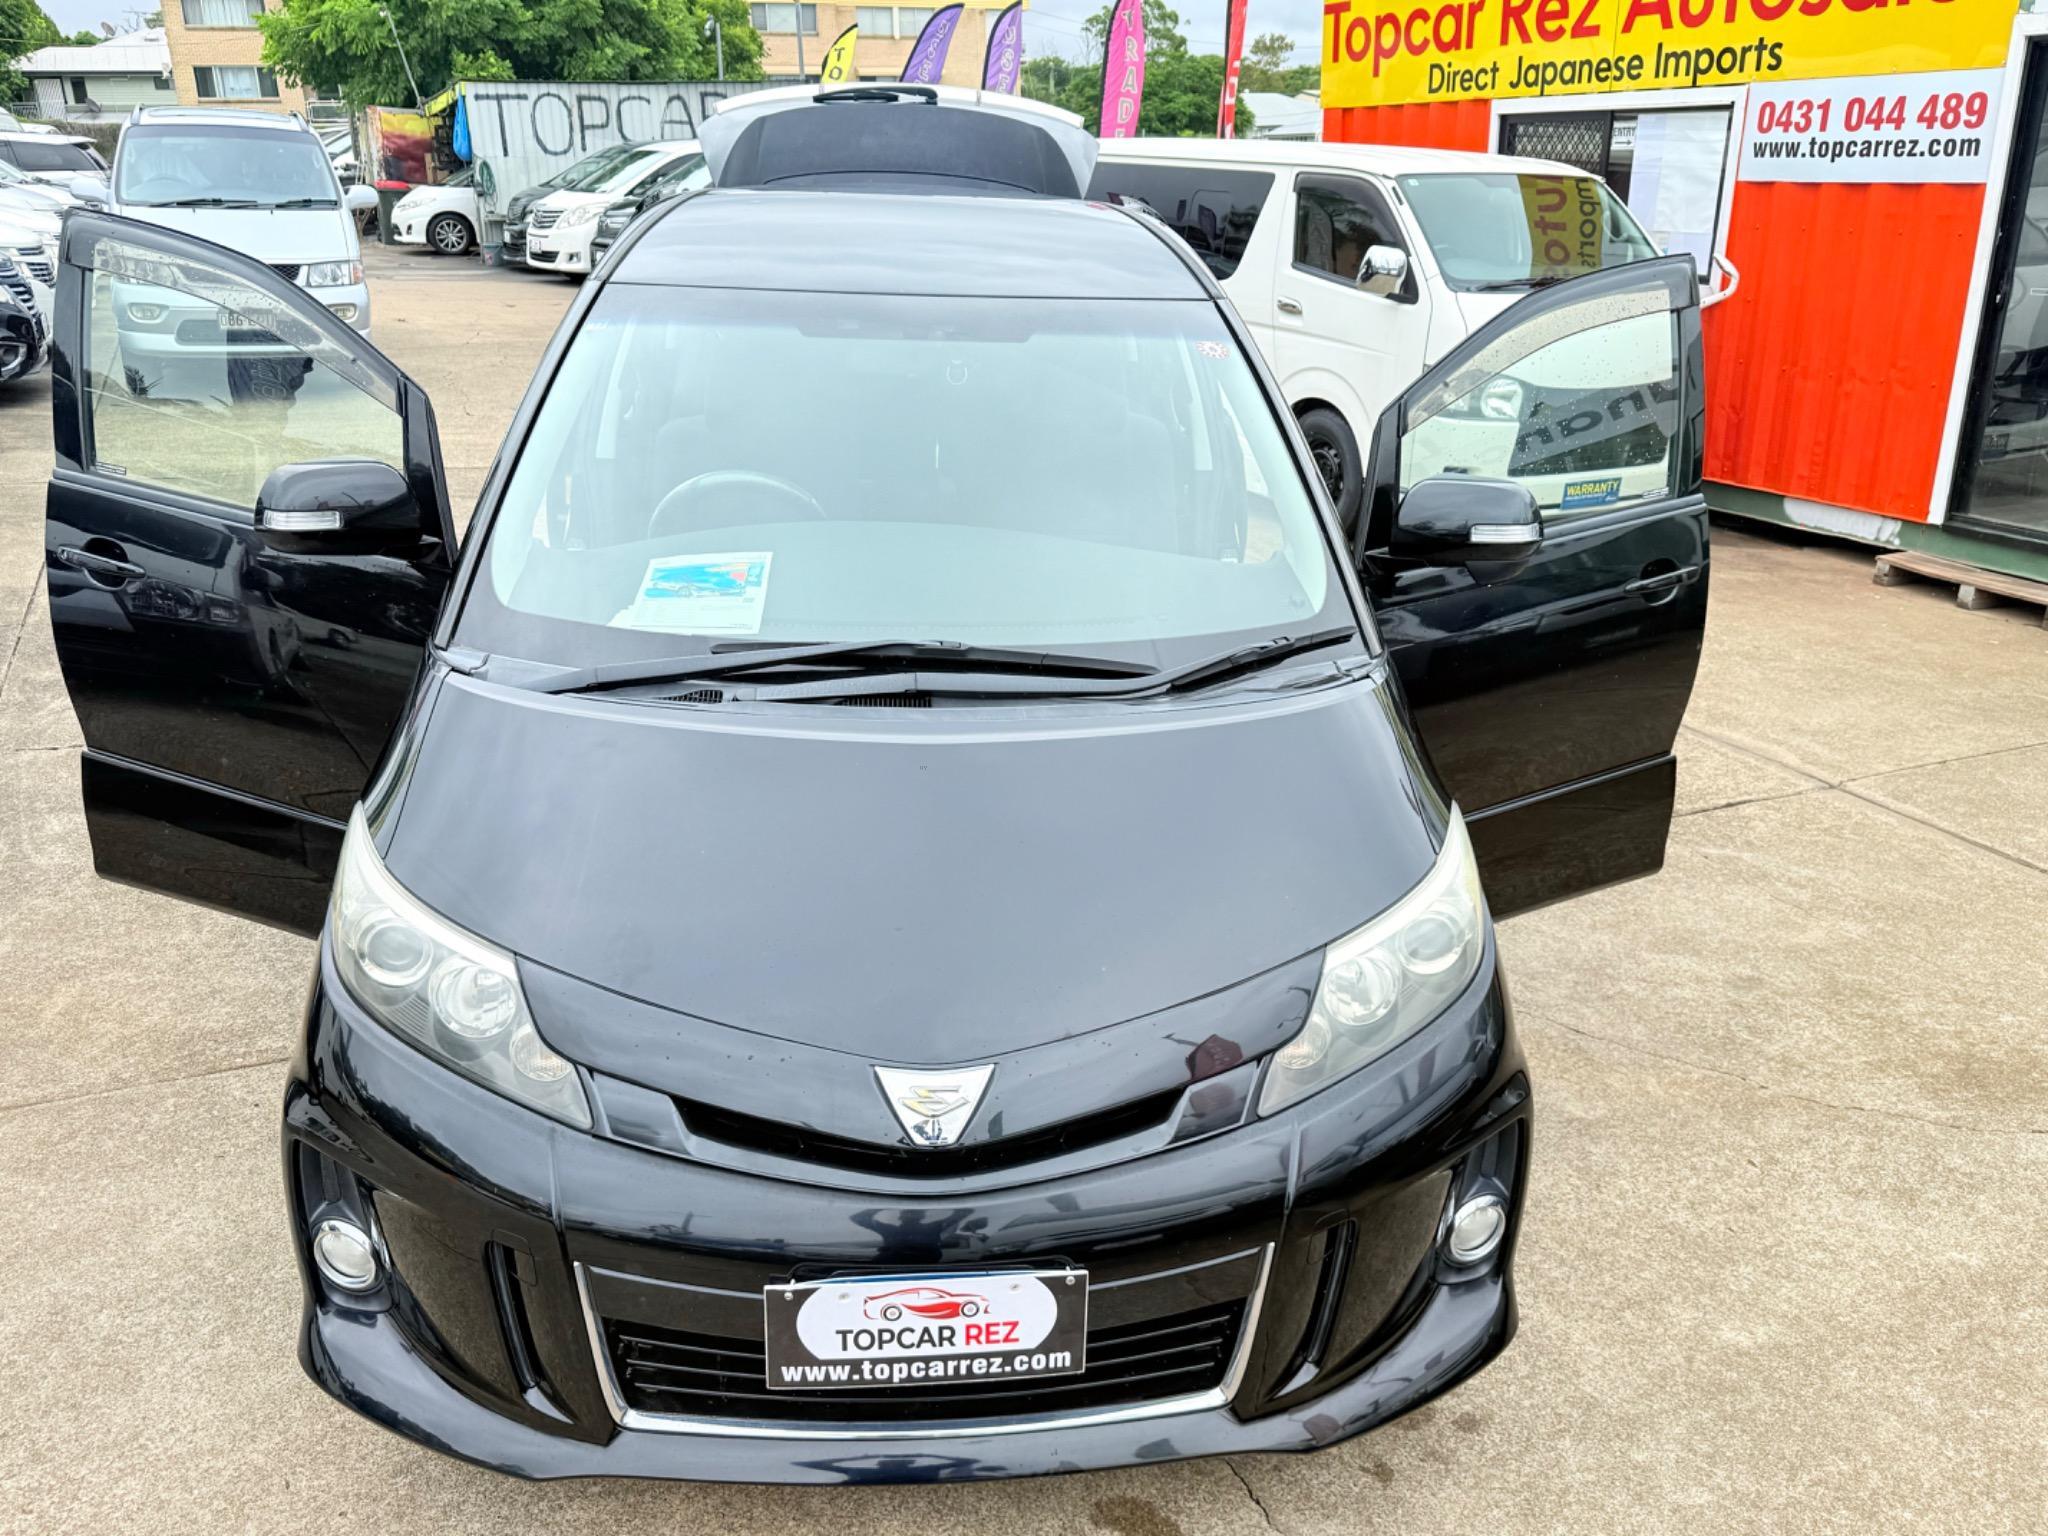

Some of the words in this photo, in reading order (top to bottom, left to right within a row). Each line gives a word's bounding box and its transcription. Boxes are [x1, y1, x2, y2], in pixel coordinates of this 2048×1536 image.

[1323, 0, 1486, 78] Topcar
[1498, 0, 1600, 47] Rez
[1428, 60, 1500, 95] Direct
[1509, 51, 1644, 97] Japanese
[1654, 36, 1784, 87] Imports
[1756, 98, 1832, 134] 0431
[1843, 95, 1907, 133] 044
[1916, 91, 1989, 130] 489
[1753, 136, 1981, 163] www.topcarrez.com
[1567, 480, 1620, 497] WARRANTY
[835, 1325, 957, 1352] TOPCAR
[964, 1320, 1020, 1346] REZ
[781, 1350, 1072, 1384] www.topcarrez.com
